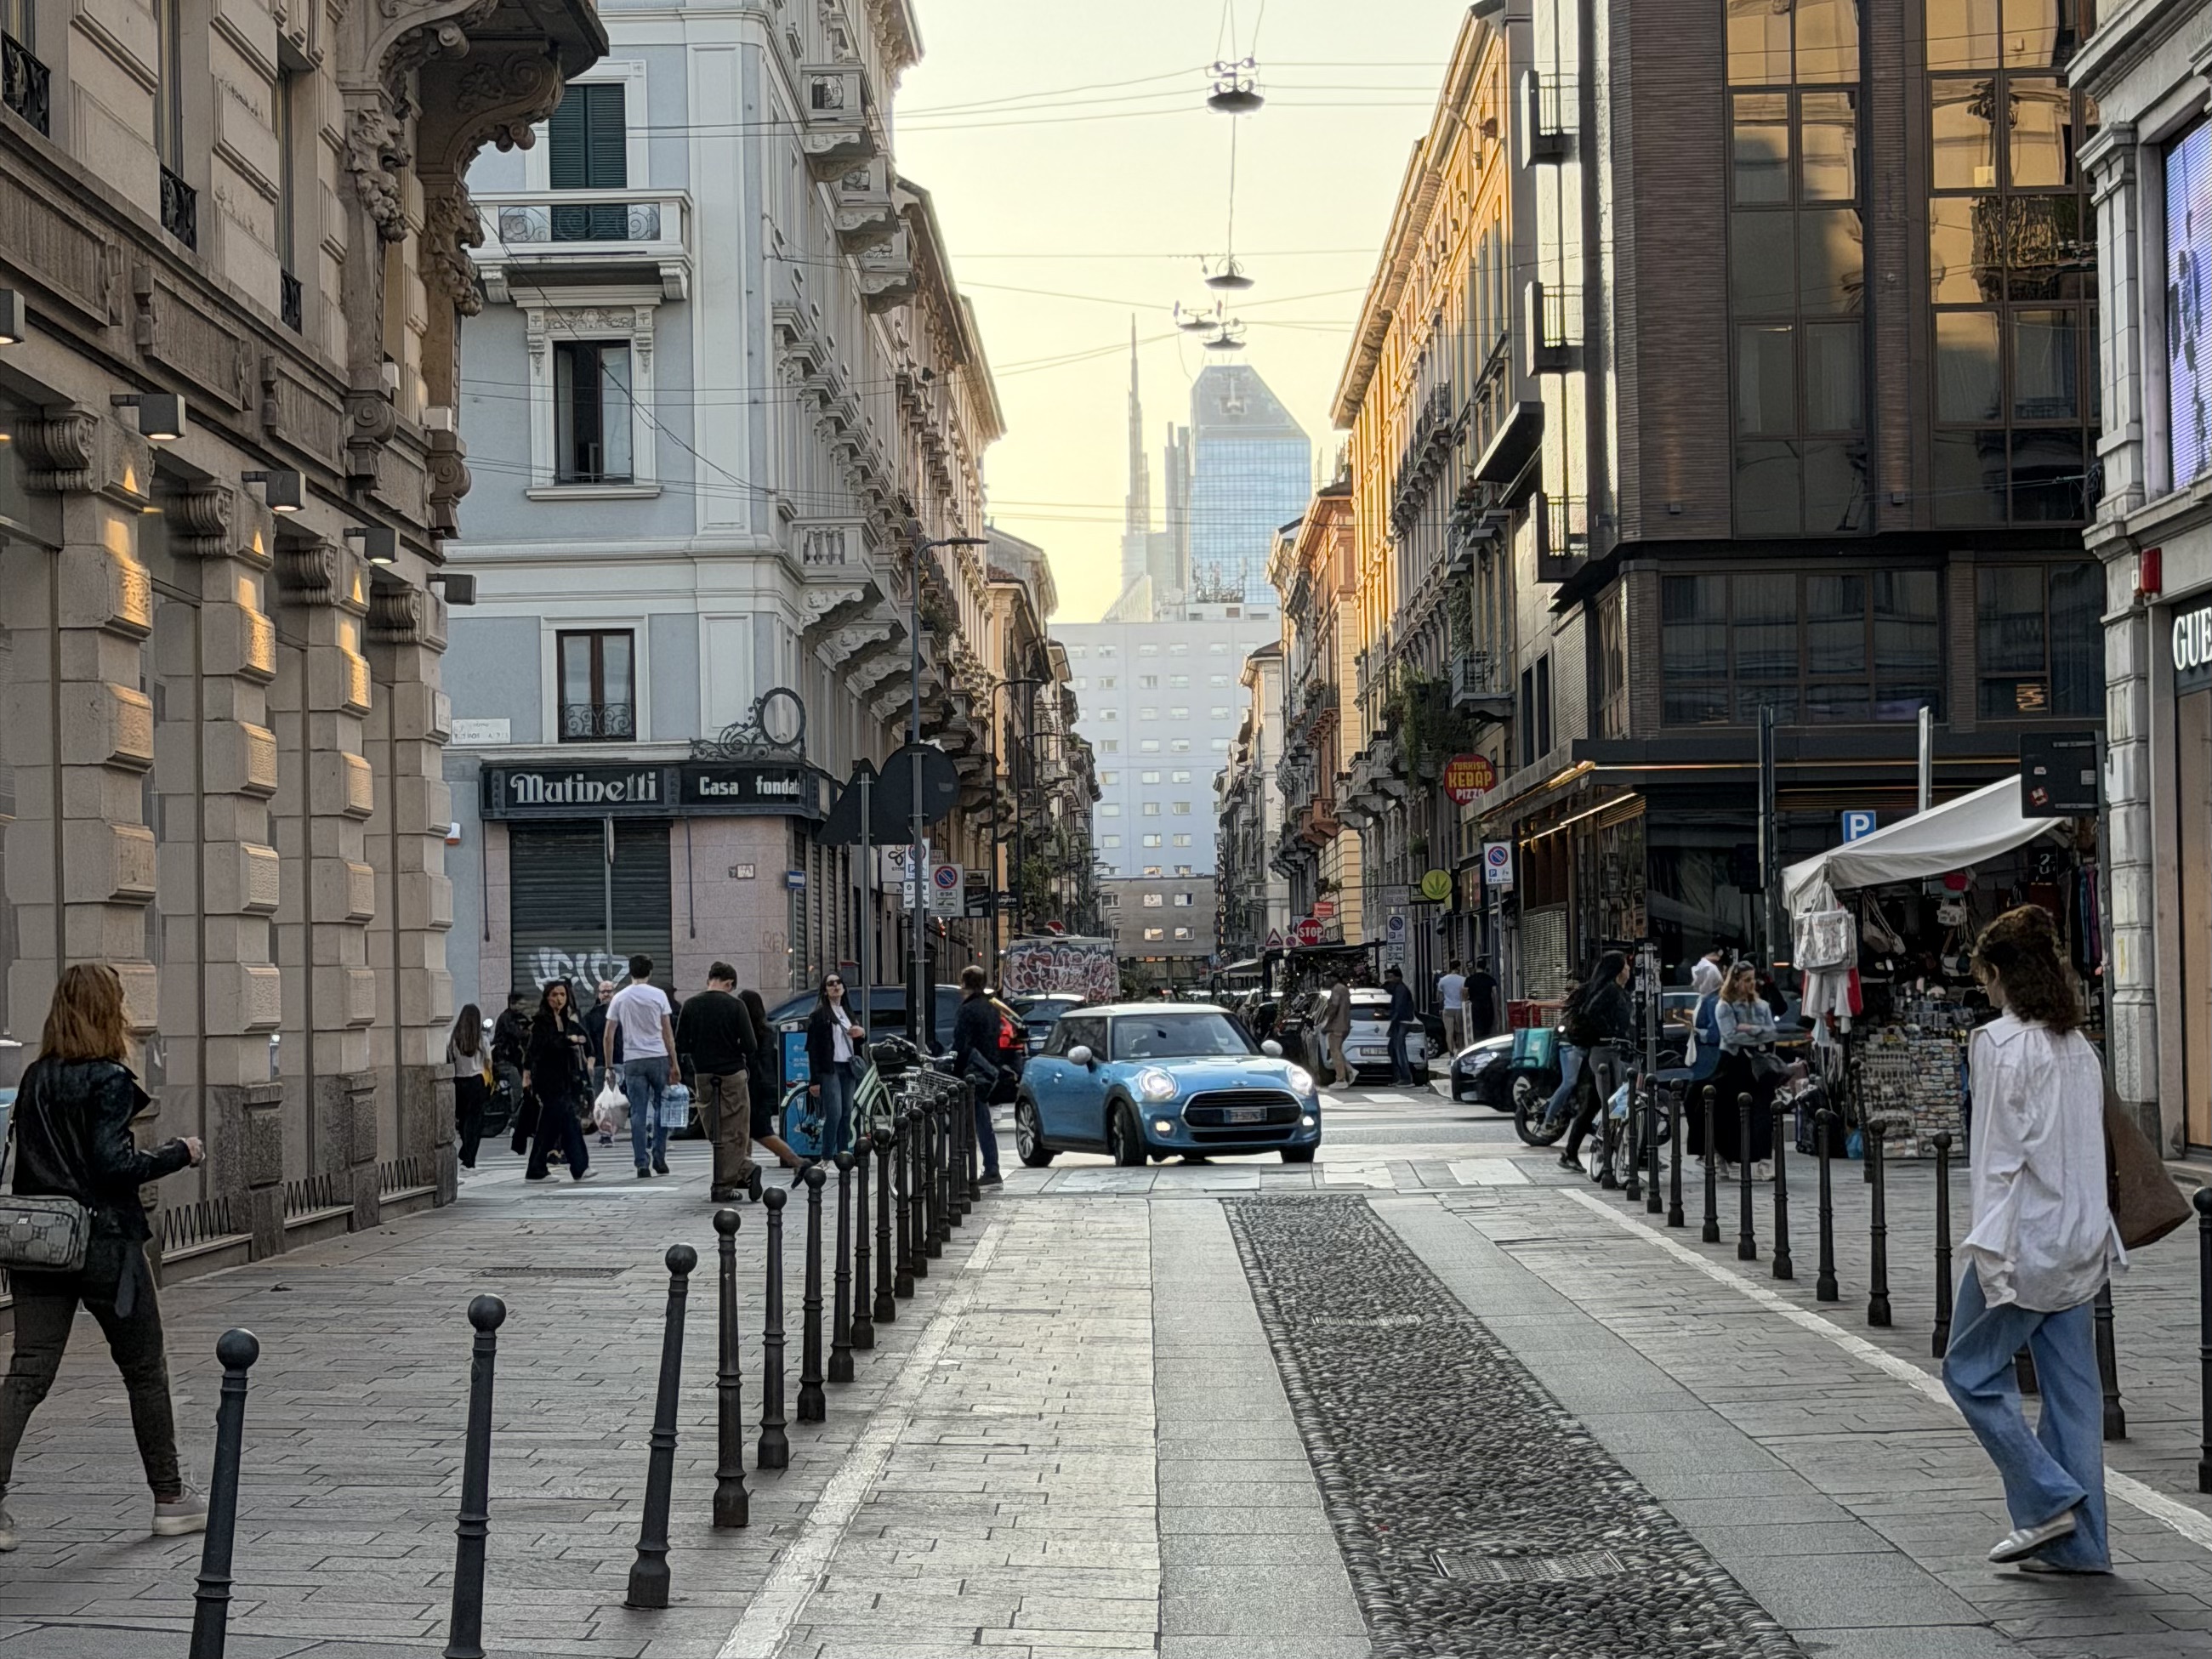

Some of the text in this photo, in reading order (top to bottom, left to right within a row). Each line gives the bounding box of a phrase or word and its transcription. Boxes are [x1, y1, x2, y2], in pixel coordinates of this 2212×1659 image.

[2172, 606, 2212, 671] GUE
[1453, 761, 1487, 770] TURKISH
[510, 771, 657, 804] Mutinelli
[699, 776, 739, 796] Casa
[1448, 770, 1493, 788] KEBAP
[1850, 814, 1870, 840] P
[1299, 927, 1323, 938] STOP
